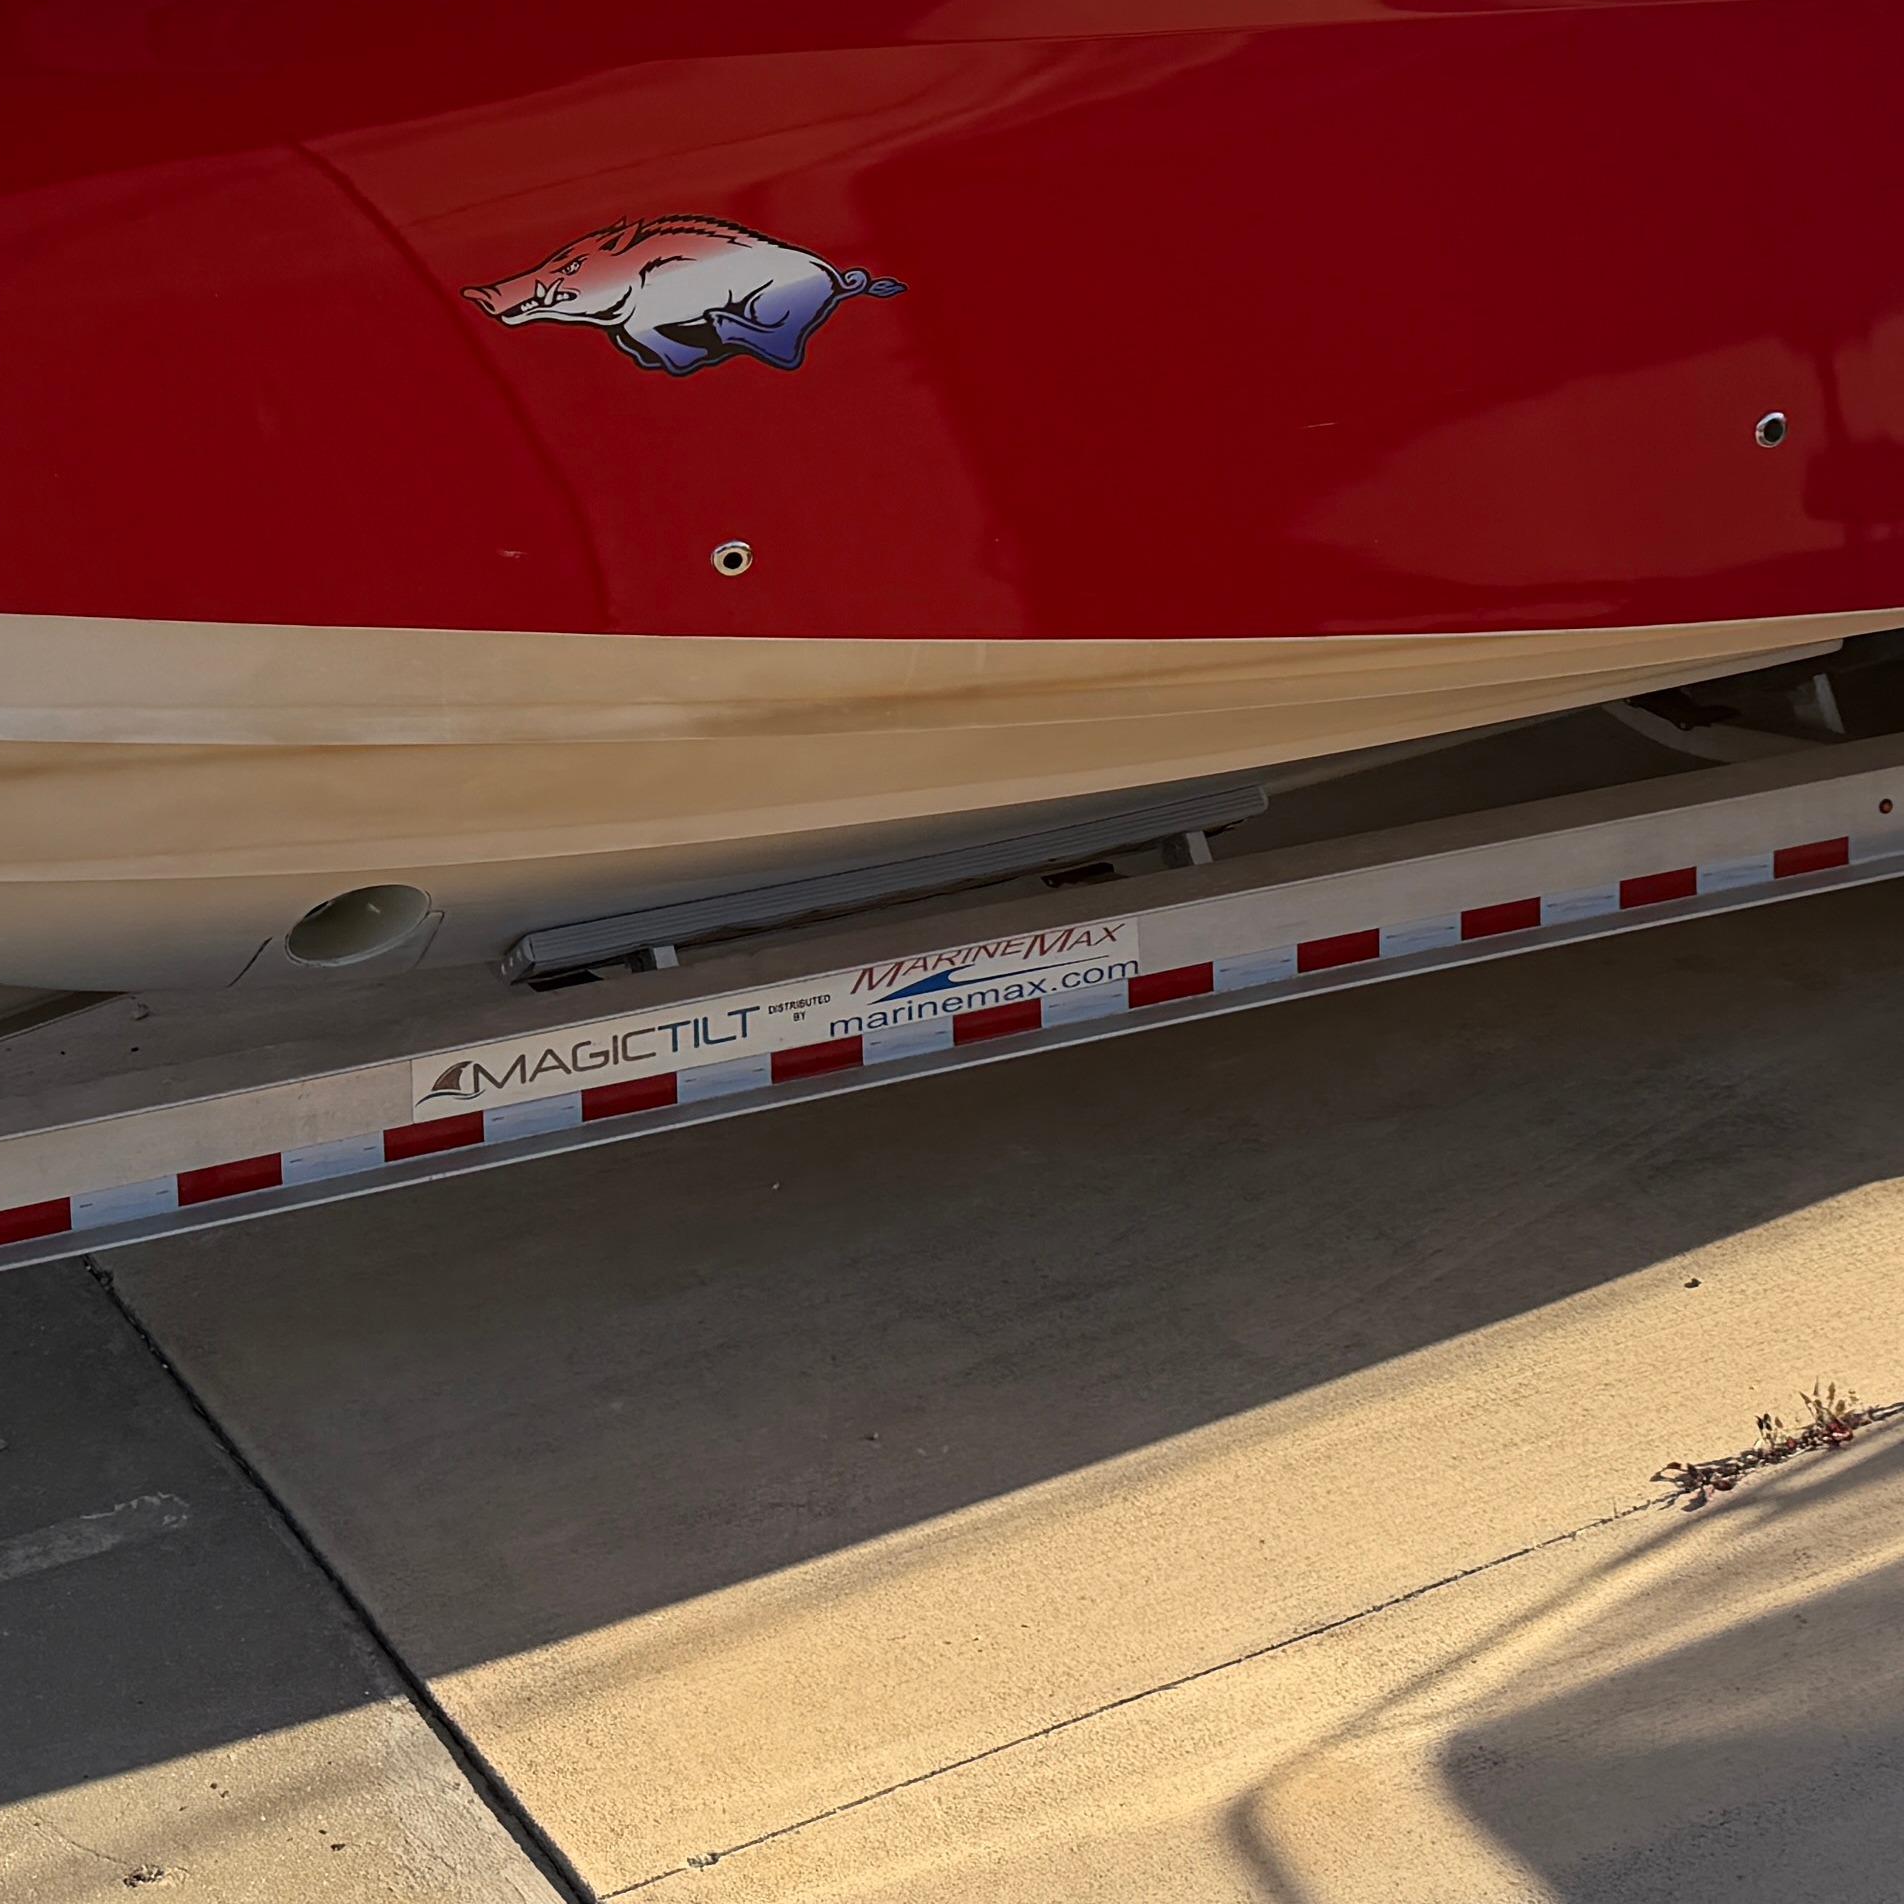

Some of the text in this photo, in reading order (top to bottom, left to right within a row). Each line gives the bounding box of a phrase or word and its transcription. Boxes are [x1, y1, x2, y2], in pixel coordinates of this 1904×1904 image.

[767, 993, 832, 1016] DISTRIBUTED
[792, 1010, 807, 1023] BY
[828, 959, 1140, 1038] marinemax.com
[472, 1006, 761, 1094] MAGICTILT
